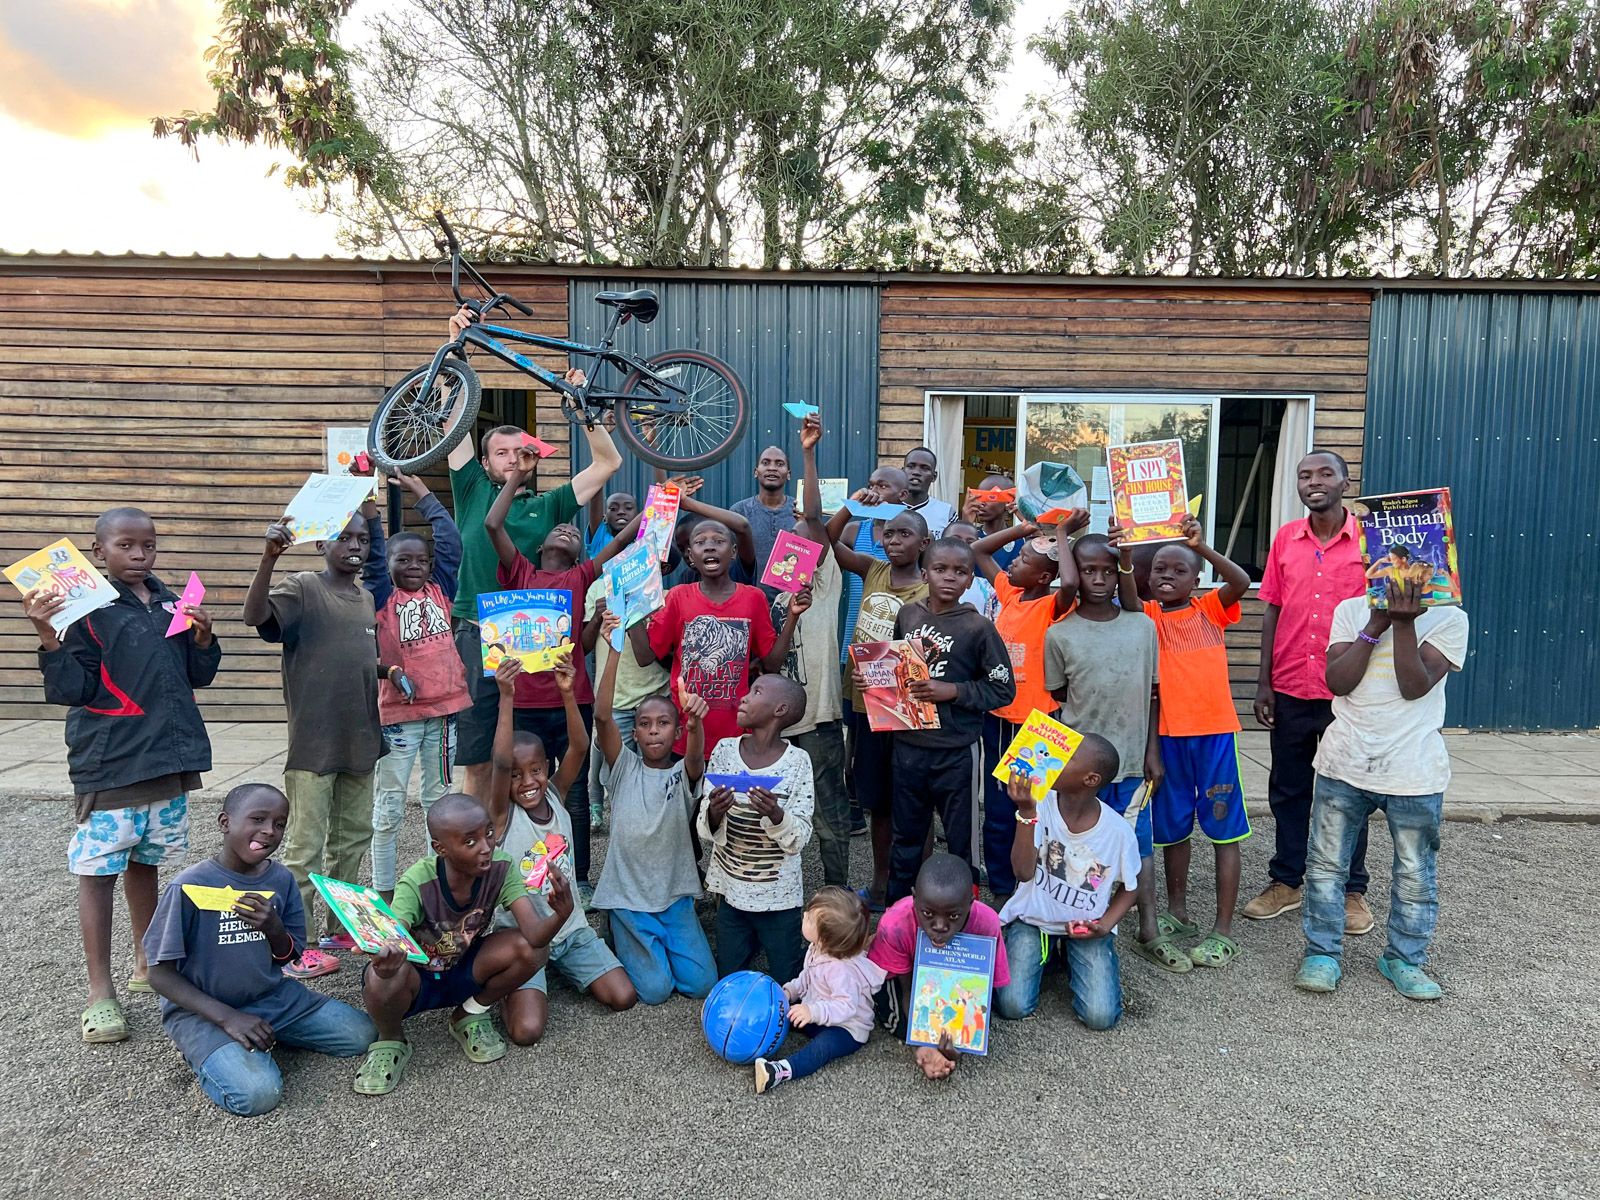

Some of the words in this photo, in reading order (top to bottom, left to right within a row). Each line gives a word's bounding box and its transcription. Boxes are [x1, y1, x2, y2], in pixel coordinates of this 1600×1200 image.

[1130, 463, 1136, 480] I
[1140, 460, 1162, 479] SPY
[1125, 483, 1143, 495] FUN
[1145, 480, 1173, 493] HOUSE
[1372, 511, 1445, 529] Human
[1380, 526, 1428, 548] Body
[872, 624, 894, 638] BETTE
[867, 662, 884, 670] THE
[862, 670, 895, 679] HUMAN
[867, 678, 891, 686] BODY
[1027, 724, 1071, 752] BALLOONS
[1040, 723, 1068, 741] SUPER
[1035, 866, 1098, 911] OMIES
[218, 931, 267, 945] ELEMEN
[924, 947, 962, 957] CHILDREN'S
[963, 953, 986, 961] WORLD
